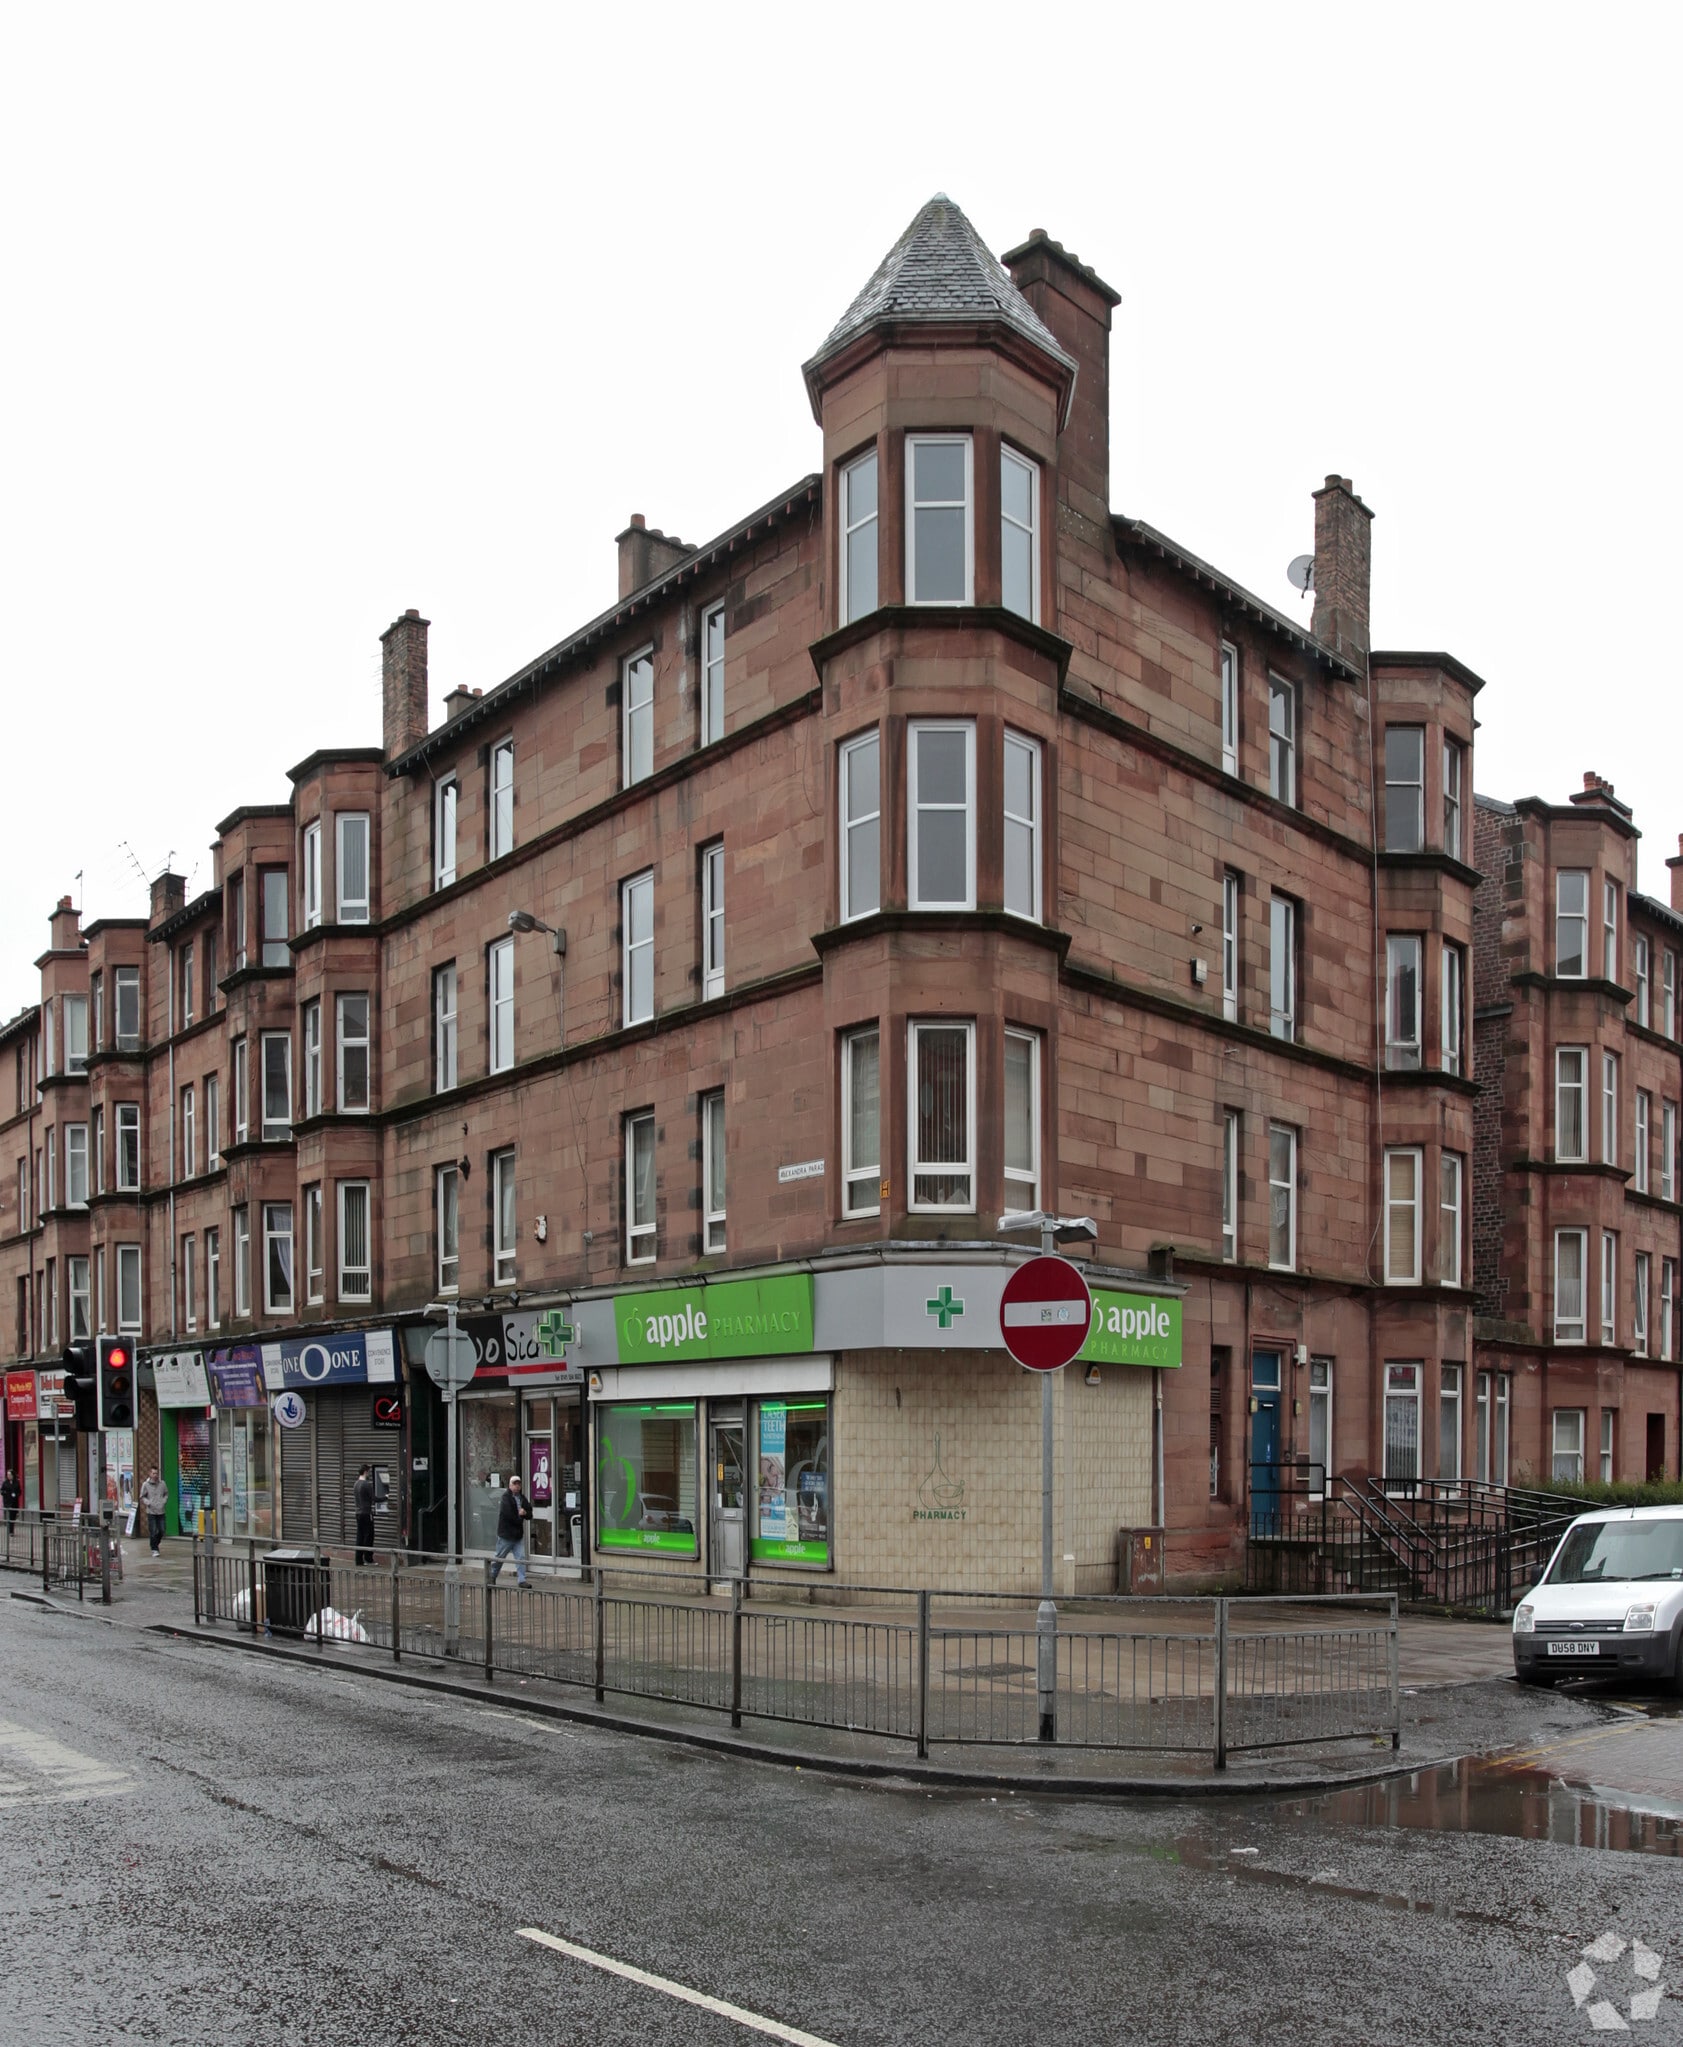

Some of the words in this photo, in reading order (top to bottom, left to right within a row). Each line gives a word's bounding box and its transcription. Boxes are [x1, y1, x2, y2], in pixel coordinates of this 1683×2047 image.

[780, 1167, 807, 1178] ALEXANDRA
[808, 1162, 824, 1172] PARAD
[646, 1303, 708, 1348] apple
[712, 1311, 801, 1338] PHARMACY
[1107, 1303, 1170, 1340] apple
[1091, 1340, 1168, 1360] PHARMACY
[283, 1356, 300, 1374] ONE
[331, 1349, 361, 1369] ONE
[763, 1420, 785, 1432] TEETH
[912, 1509, 967, 1520] PHARMACY
[643, 1532, 660, 1544] apple
[785, 1542, 806, 1555] apple
[1551, 1643, 1575, 1653] DU58
[1578, 1643, 1595, 1653] DNY
